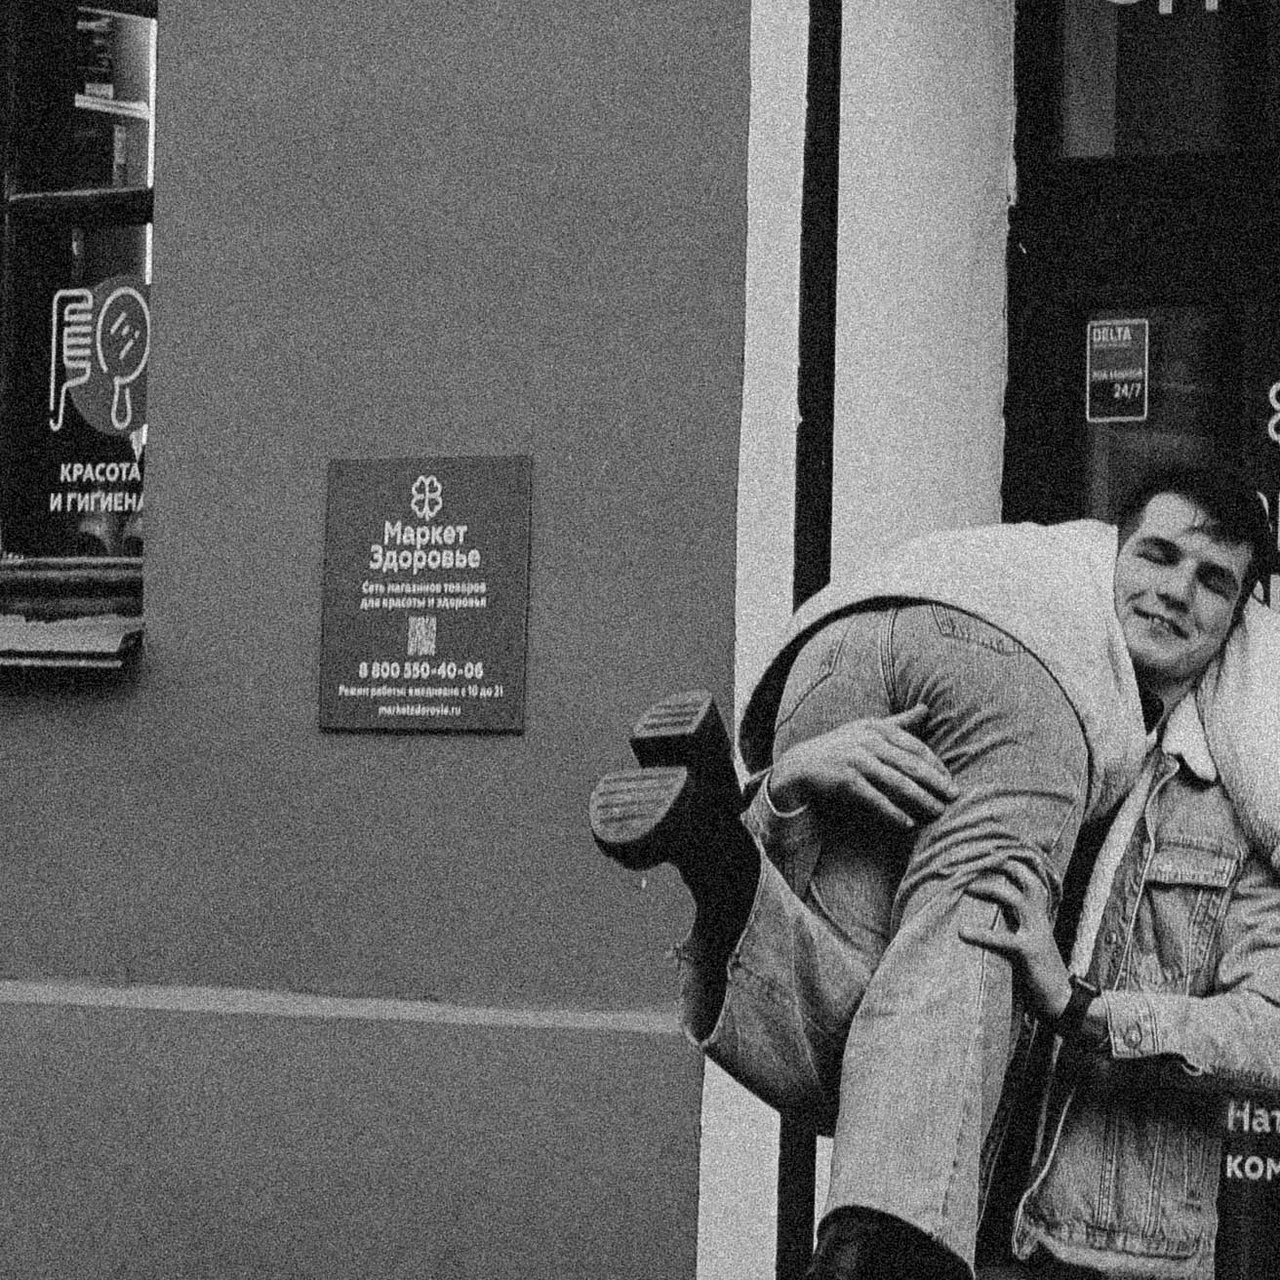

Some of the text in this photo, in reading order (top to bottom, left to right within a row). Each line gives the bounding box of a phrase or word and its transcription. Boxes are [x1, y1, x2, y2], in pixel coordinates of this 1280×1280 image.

[1093, 327, 1132, 343] DELTA
[1114, 382, 1141, 399] 24/7
[60, 462, 141, 482] КРАСОТА
[50, 492, 62, 512] И
[384, 520, 468, 550] Маркет
[369, 544, 481, 575] Здоровье
[359, 661, 368, 679] 8
[371, 661, 401, 679] 800
[468, 685, 478, 697] 10
